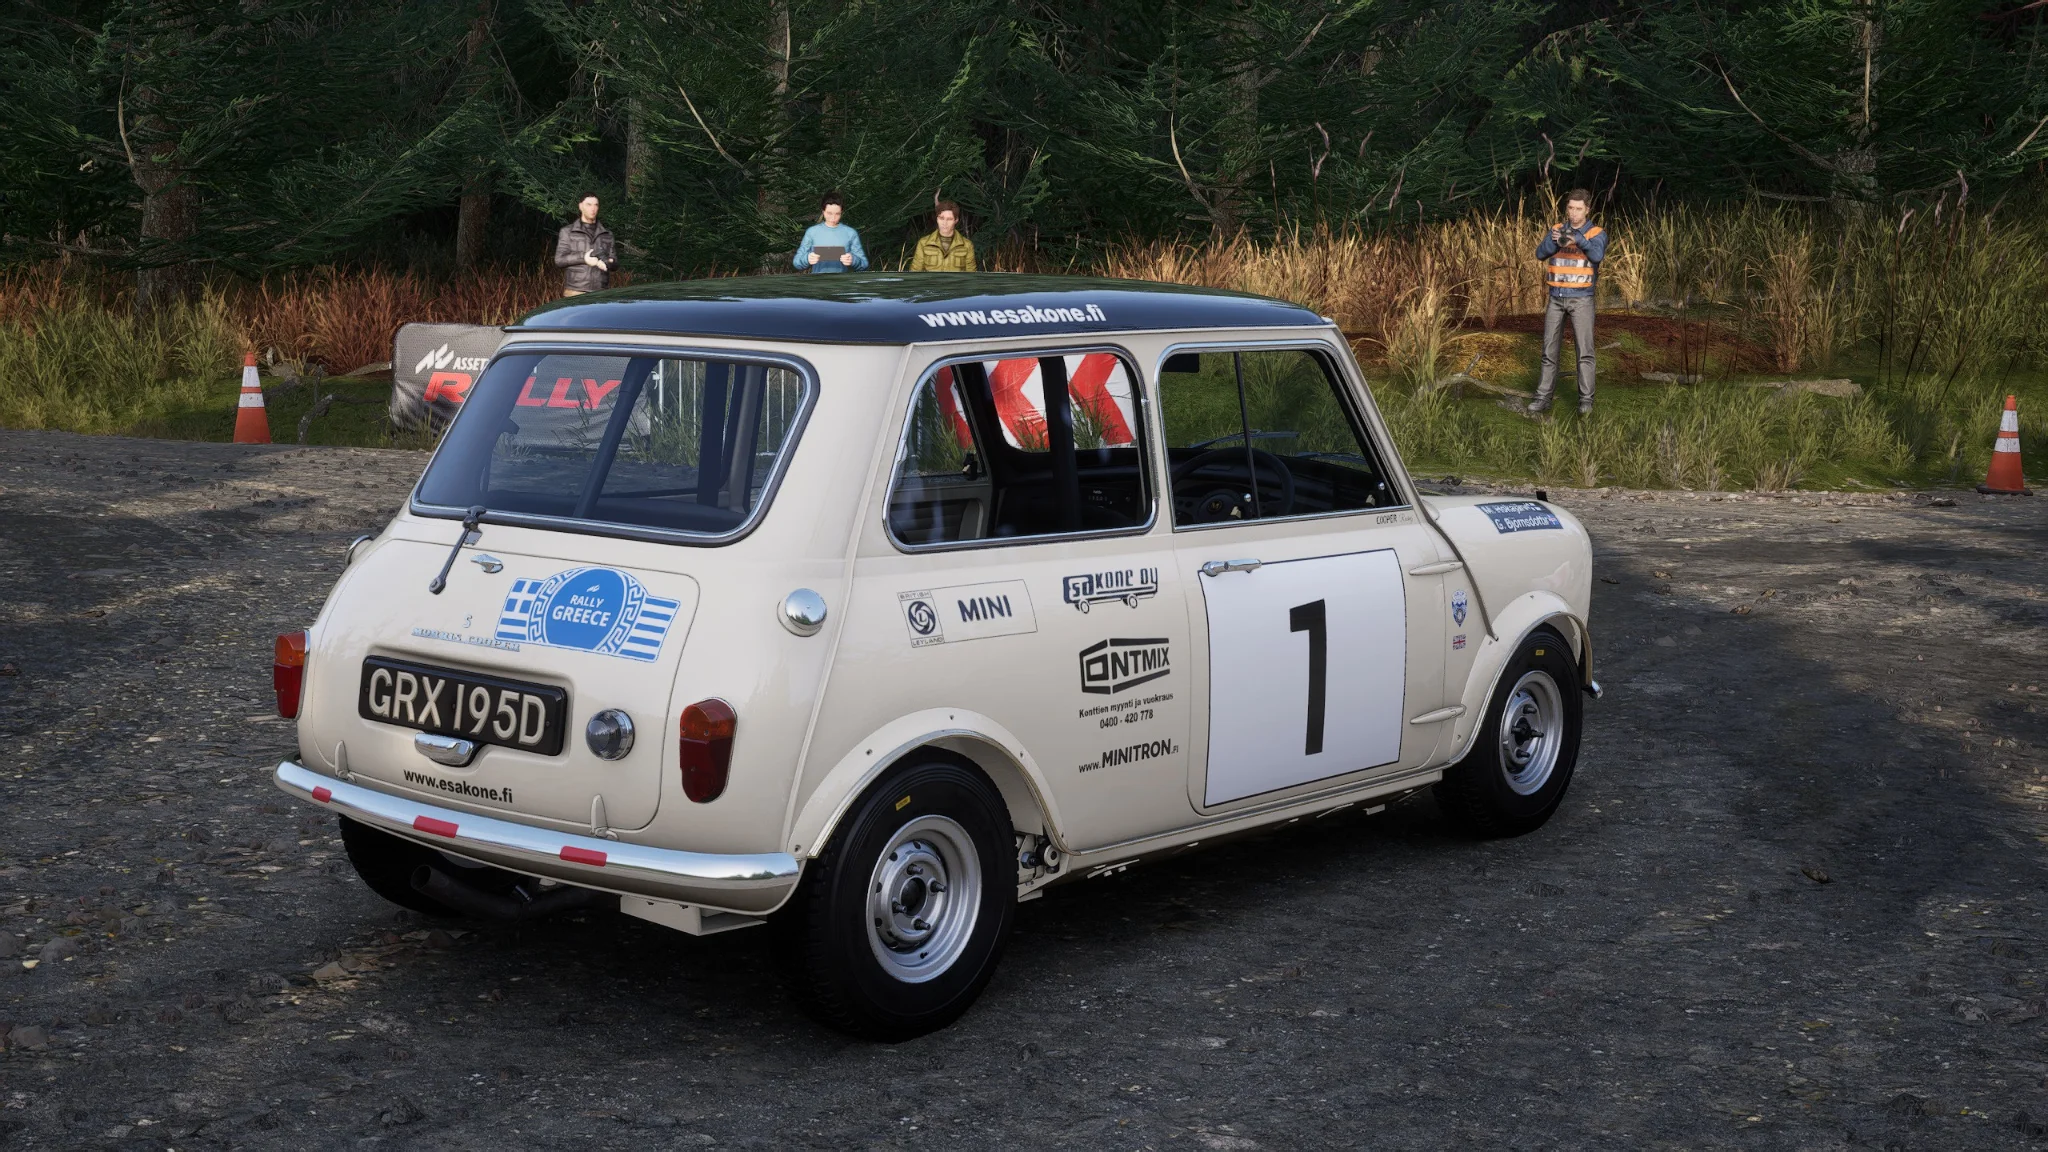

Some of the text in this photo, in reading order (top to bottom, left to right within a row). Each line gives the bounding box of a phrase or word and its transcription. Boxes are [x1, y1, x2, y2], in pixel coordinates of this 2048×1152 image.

[918, 303, 1106, 327] www.esakone.fi
[423, 371, 622, 409] RLLY
[1495, 519, 1507, 530] G.
[569, 594, 605, 608] RALLY
[899, 590, 931, 600] BRITISH
[552, 604, 611, 627] GREECE
[957, 594, 1012, 623] MINI
[911, 636, 944, 647] LEYLAND
[1289, 598, 1327, 756] 1
[368, 668, 547, 746] GRX 195D
[1079, 692, 1174, 719] Konttien myynti ja vuokraus
[1099, 715, 1118, 729] 0400
[1124, 711, 1138, 724] 420
[1139, 708, 1154, 720] 778
[403, 769, 513, 804] www.esakone.fi
